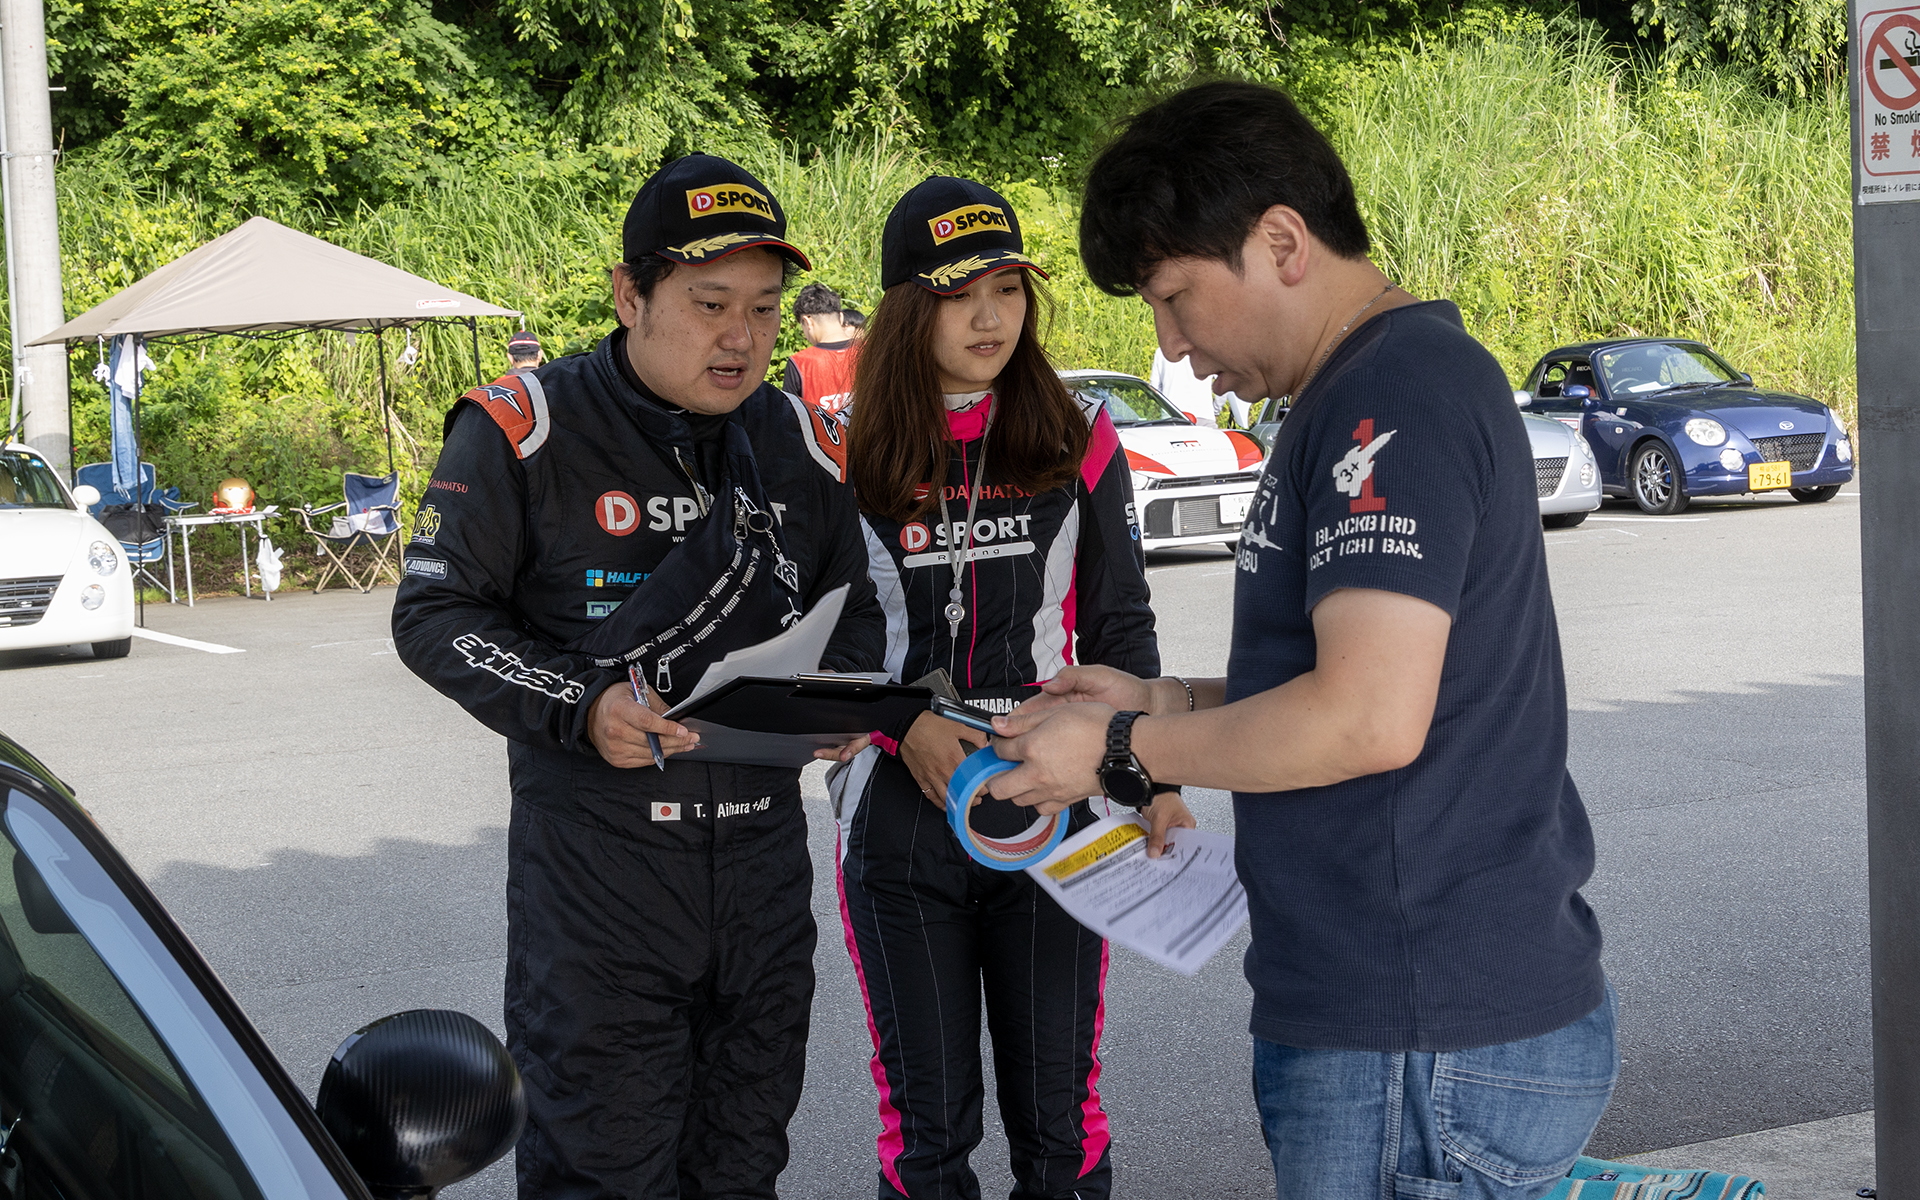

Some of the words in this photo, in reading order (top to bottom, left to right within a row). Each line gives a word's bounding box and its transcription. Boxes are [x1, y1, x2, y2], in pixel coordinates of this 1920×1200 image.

[1875, 113, 1887, 126] No
[1890, 110, 1920, 125] Smoki
[716, 191, 770, 215] SPORT
[955, 210, 1006, 230] SPORT
[935, 514, 1032, 546] SPORT
[1315, 515, 1416, 547] BLACKBIRD
[937, 548, 1000, 561] Ring
[1339, 537, 1374, 556] ICHI
[409, 560, 445, 574] ADVANCE
[606, 571, 642, 584] HALF
[709, 575, 730, 598] PUMA
[684, 604, 706, 626] PUMA
[721, 594, 741, 617] PUMA
[656, 627, 679, 643] PUMA
[693, 623, 717, 643] PUMA
[624, 646, 648, 662] PUMA
[694, 803, 706, 818] T.
[717, 802, 750, 818] Aihara
